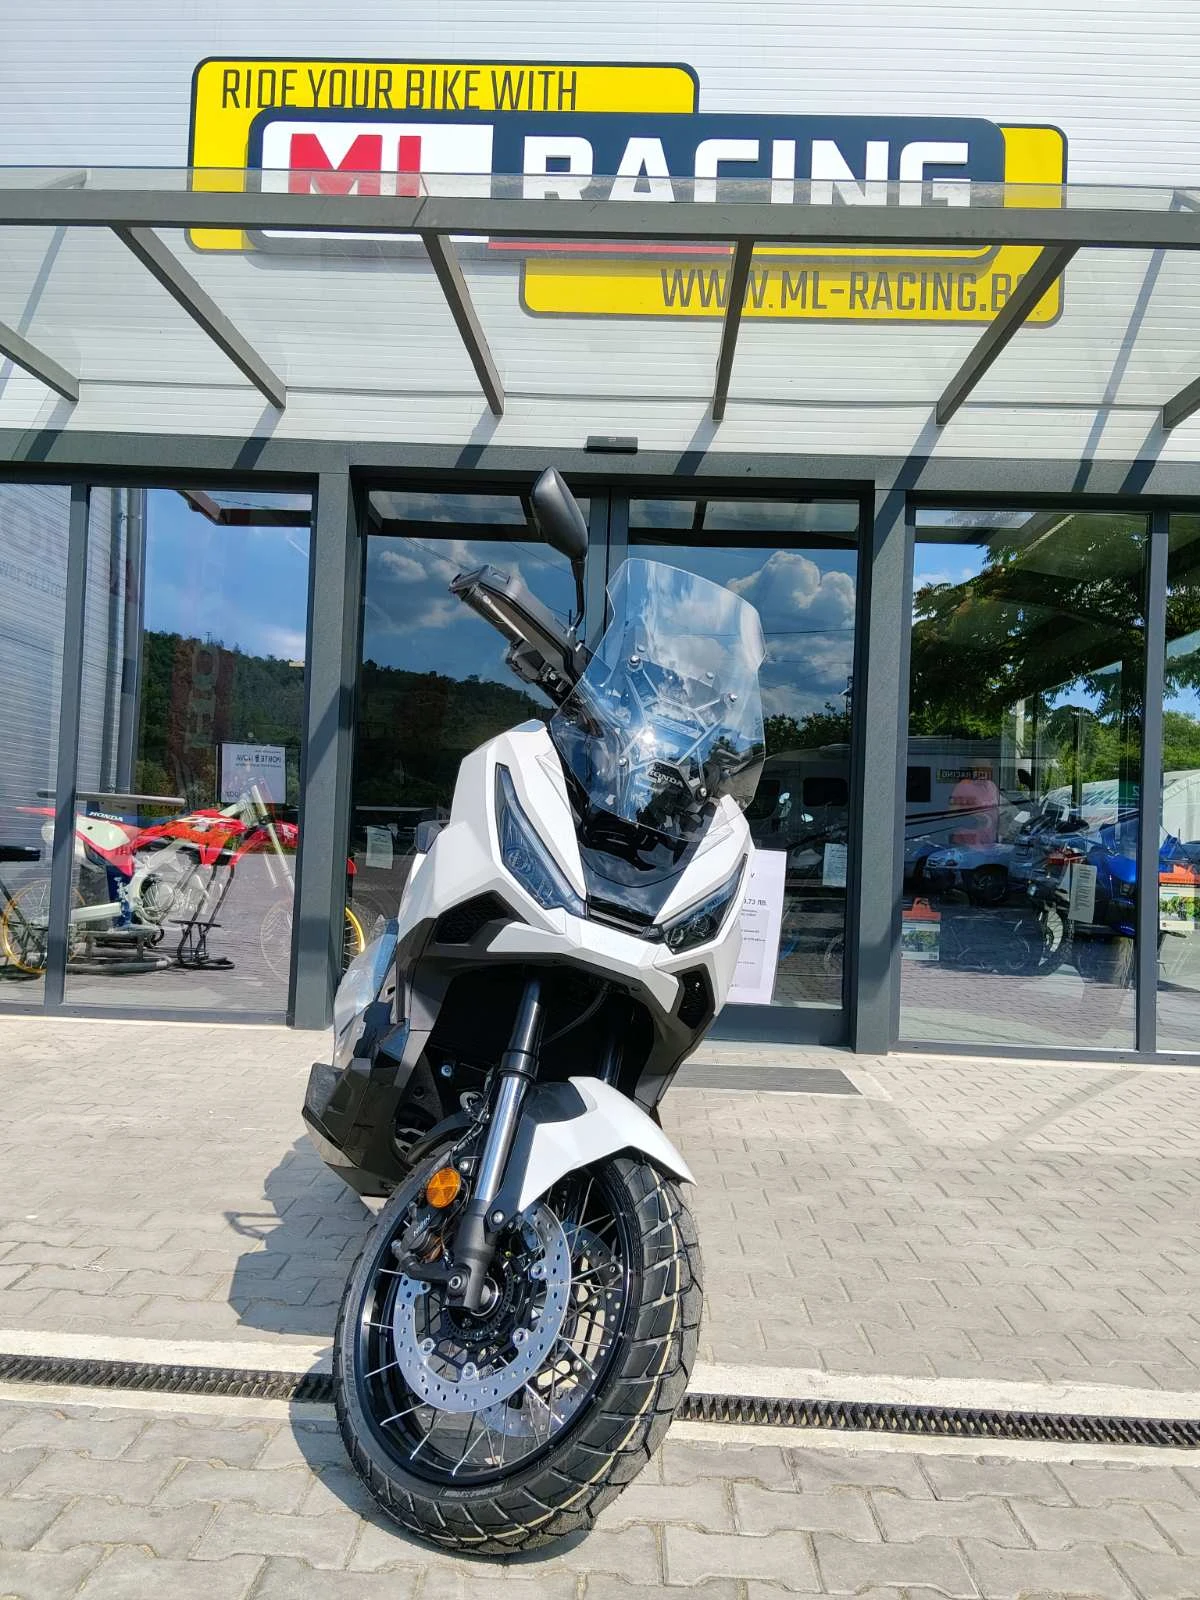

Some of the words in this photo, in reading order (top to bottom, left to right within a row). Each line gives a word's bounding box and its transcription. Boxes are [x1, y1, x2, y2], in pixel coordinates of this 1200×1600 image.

[221, 69, 298, 109] RIDE
[307, 69, 393, 109] YOUR
[405, 70, 481, 111] BIKE
[491, 70, 577, 111] WITH
[521, 136, 972, 207] RACING
[660, 268, 1025, 312] WWW.ML-RACING.B
[88, 811, 124, 822] HONDA
